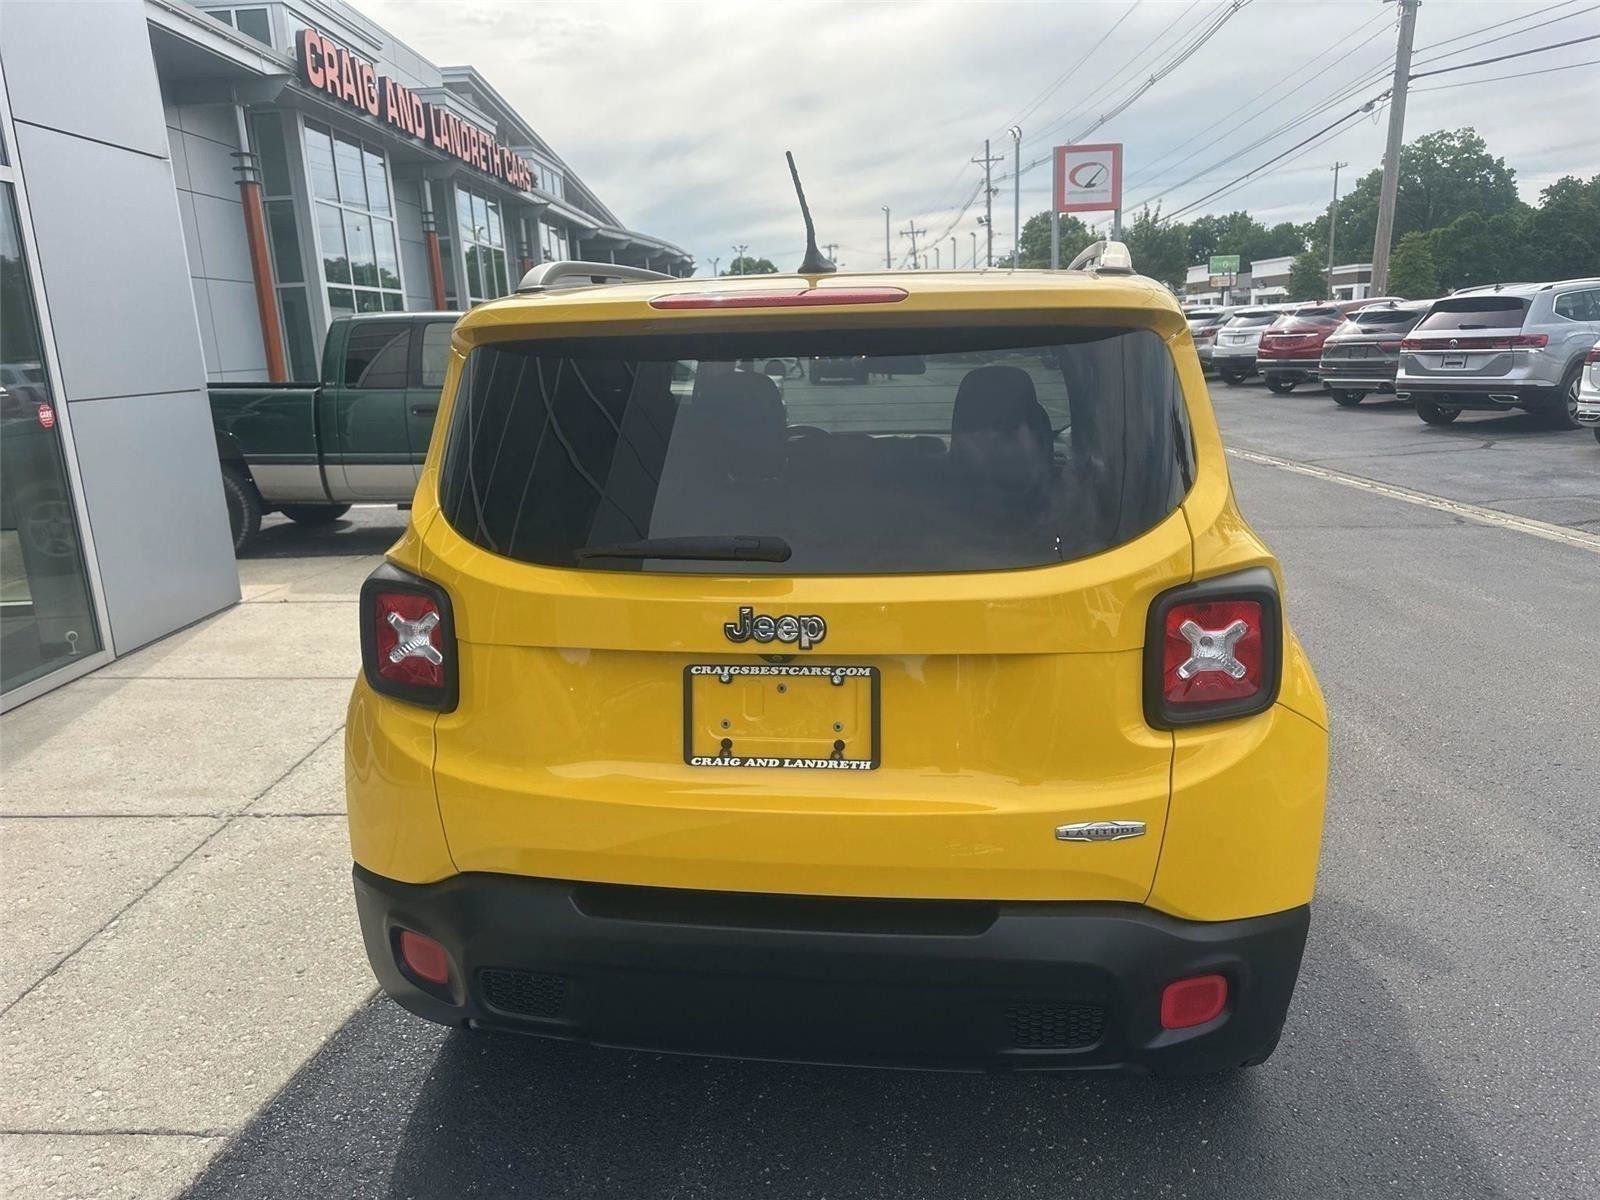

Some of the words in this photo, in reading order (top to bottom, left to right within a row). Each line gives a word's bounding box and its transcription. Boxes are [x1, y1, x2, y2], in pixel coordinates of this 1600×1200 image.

[303, 28, 380, 117] CRAIG
[385, 77, 426, 140] AND
[429, 103, 503, 178] LANDRETH
[504, 147, 533, 192] CARS
[724, 606, 827, 650] Jeep
[690, 665, 871, 676] CRAIGSBESTCARS.COM
[690, 757, 741, 767] CRAIG
[744, 758, 780, 768] AND
[783, 759, 872, 771] LANDRETH
[1064, 826, 1138, 837] LATITUDE
